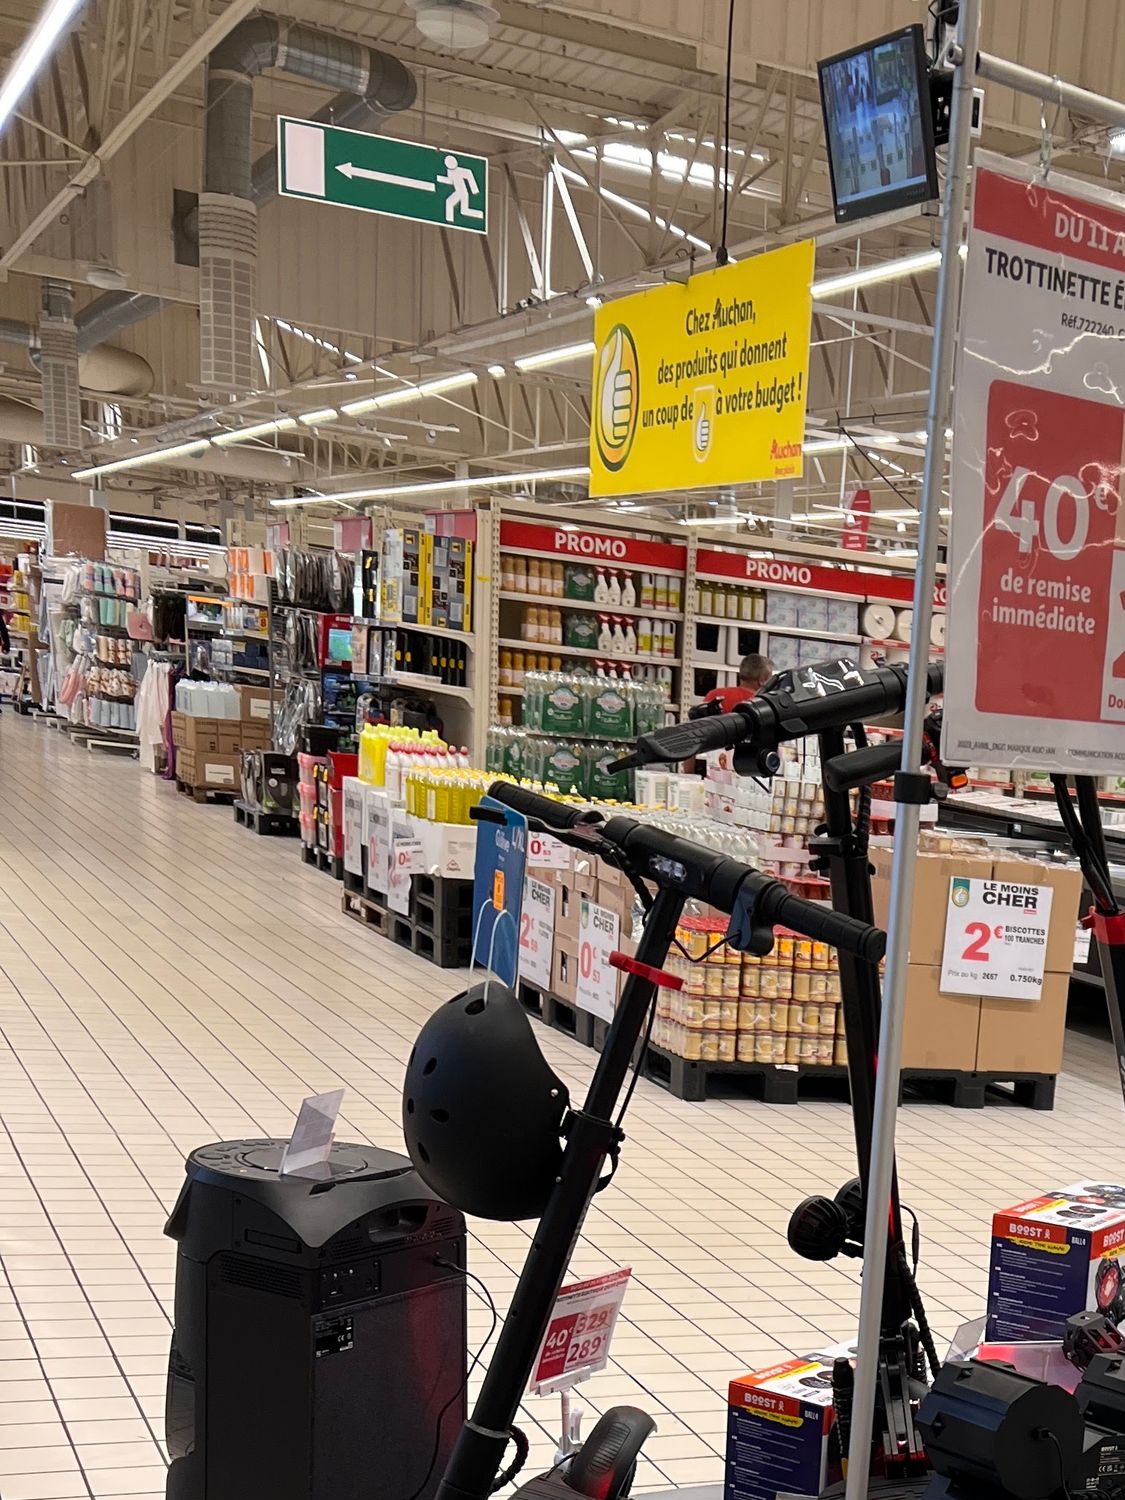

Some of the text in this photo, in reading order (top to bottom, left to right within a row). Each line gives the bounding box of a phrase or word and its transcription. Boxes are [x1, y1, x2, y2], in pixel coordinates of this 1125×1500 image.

[1055, 212, 1083, 244] DU
[1089, 220, 1109, 250] 11
[986, 248, 1110, 307] TROTTINETTE
[686, 309, 710, 336] Chez
[658, 331, 787, 388] des produits qui donnent
[642, 375, 796, 430] un coup de à votre budget
[770, 439, 802, 460] Auchan
[554, 531, 627, 559] PROMO
[745, 559, 812, 585] PROMO
[1001, 569, 1092, 604] de remise
[992, 600, 1096, 636] immédiate
[531, 888, 551, 907] CHER
[983, 882, 1040, 897] LE MOINS
[982, 891, 1039, 910] CHER
[593, 915, 615, 935] CHER
[1005, 925, 1046, 937] BISCOTTES
[1004, 934, 1046, 946] 100 TRANCHES
[1009, 1222, 1042, 1239] BOOST
[1103, 1228, 1125, 1248] BOOST
[744, 1392, 777, 1409] BOOST
